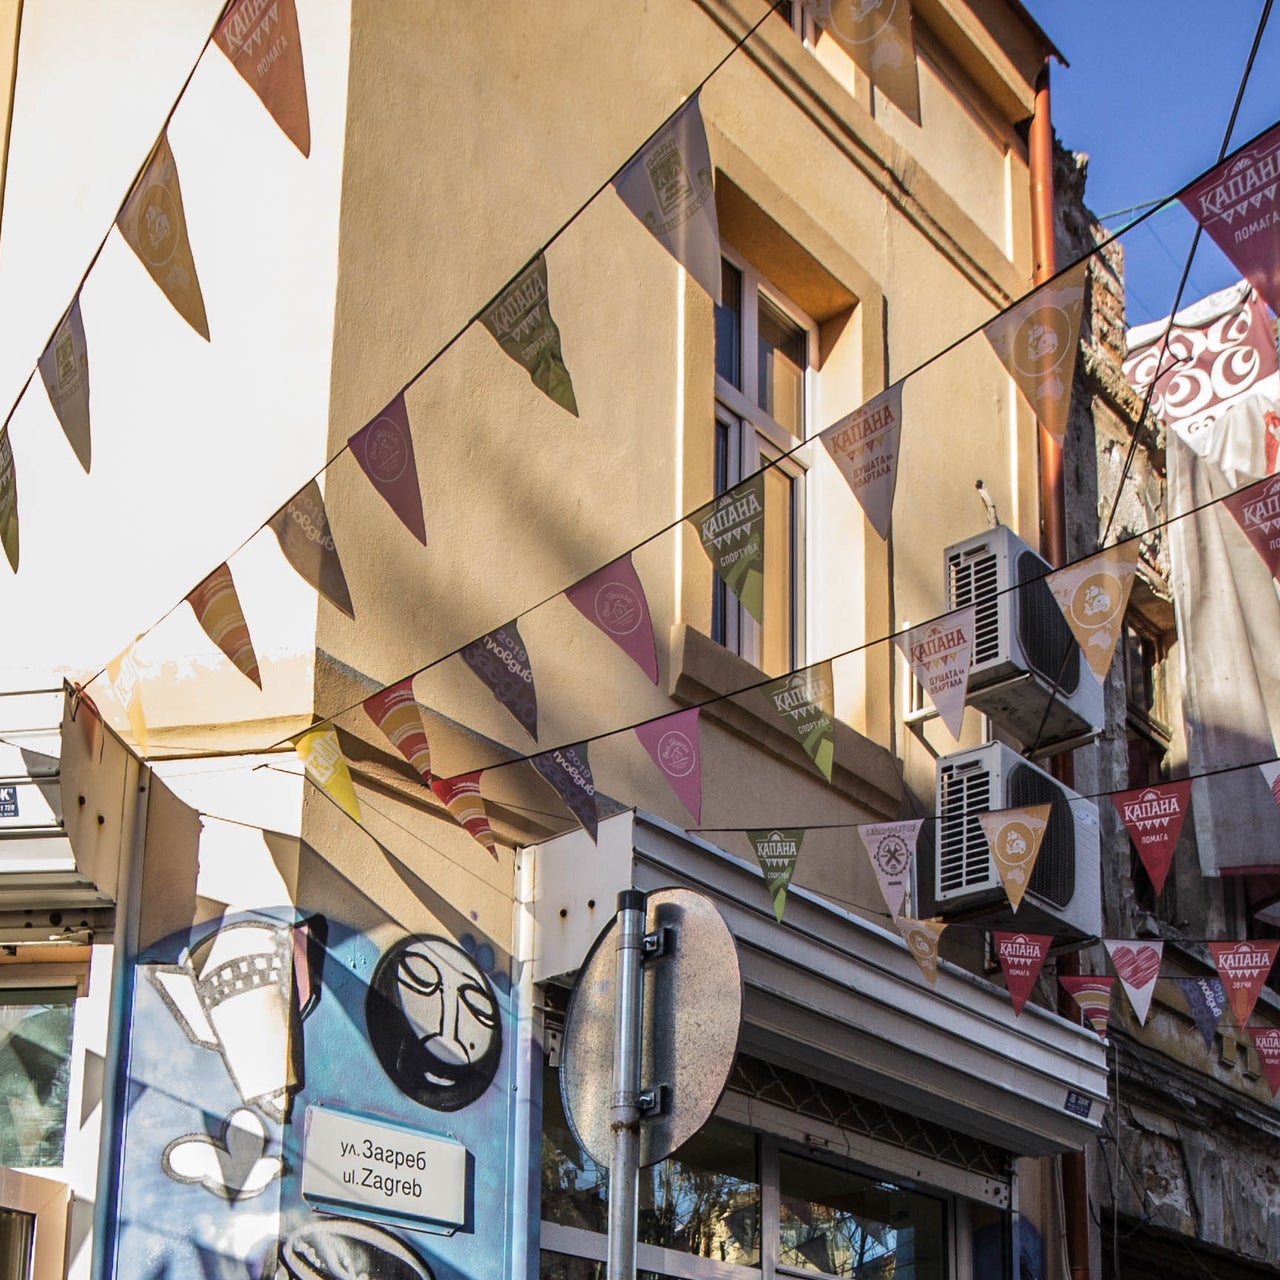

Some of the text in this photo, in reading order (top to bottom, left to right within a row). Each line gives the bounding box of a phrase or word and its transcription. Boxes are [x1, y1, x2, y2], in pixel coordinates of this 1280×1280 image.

[1234, 213, 1280, 244] ПОМАГА
[490, 276, 547, 335] КАПАНА
[832, 405, 895, 454] КАПАНА
[702, 494, 761, 540] КАПАНА
[910, 628, 968, 663] КАПАНА
[929, 668, 958, 686] ДУШАТА
[774, 681, 828, 711] КАПАНА
[566, 749, 591, 777] 2019
[1124, 798, 1180, 822] КАПАНА
[757, 842, 797, 857] КАПАНА
[1142, 833, 1168, 845] ПОМАГА
[1000, 943, 1040, 959] КАПАНА
[1219, 953, 1270, 970] КАПАНА
